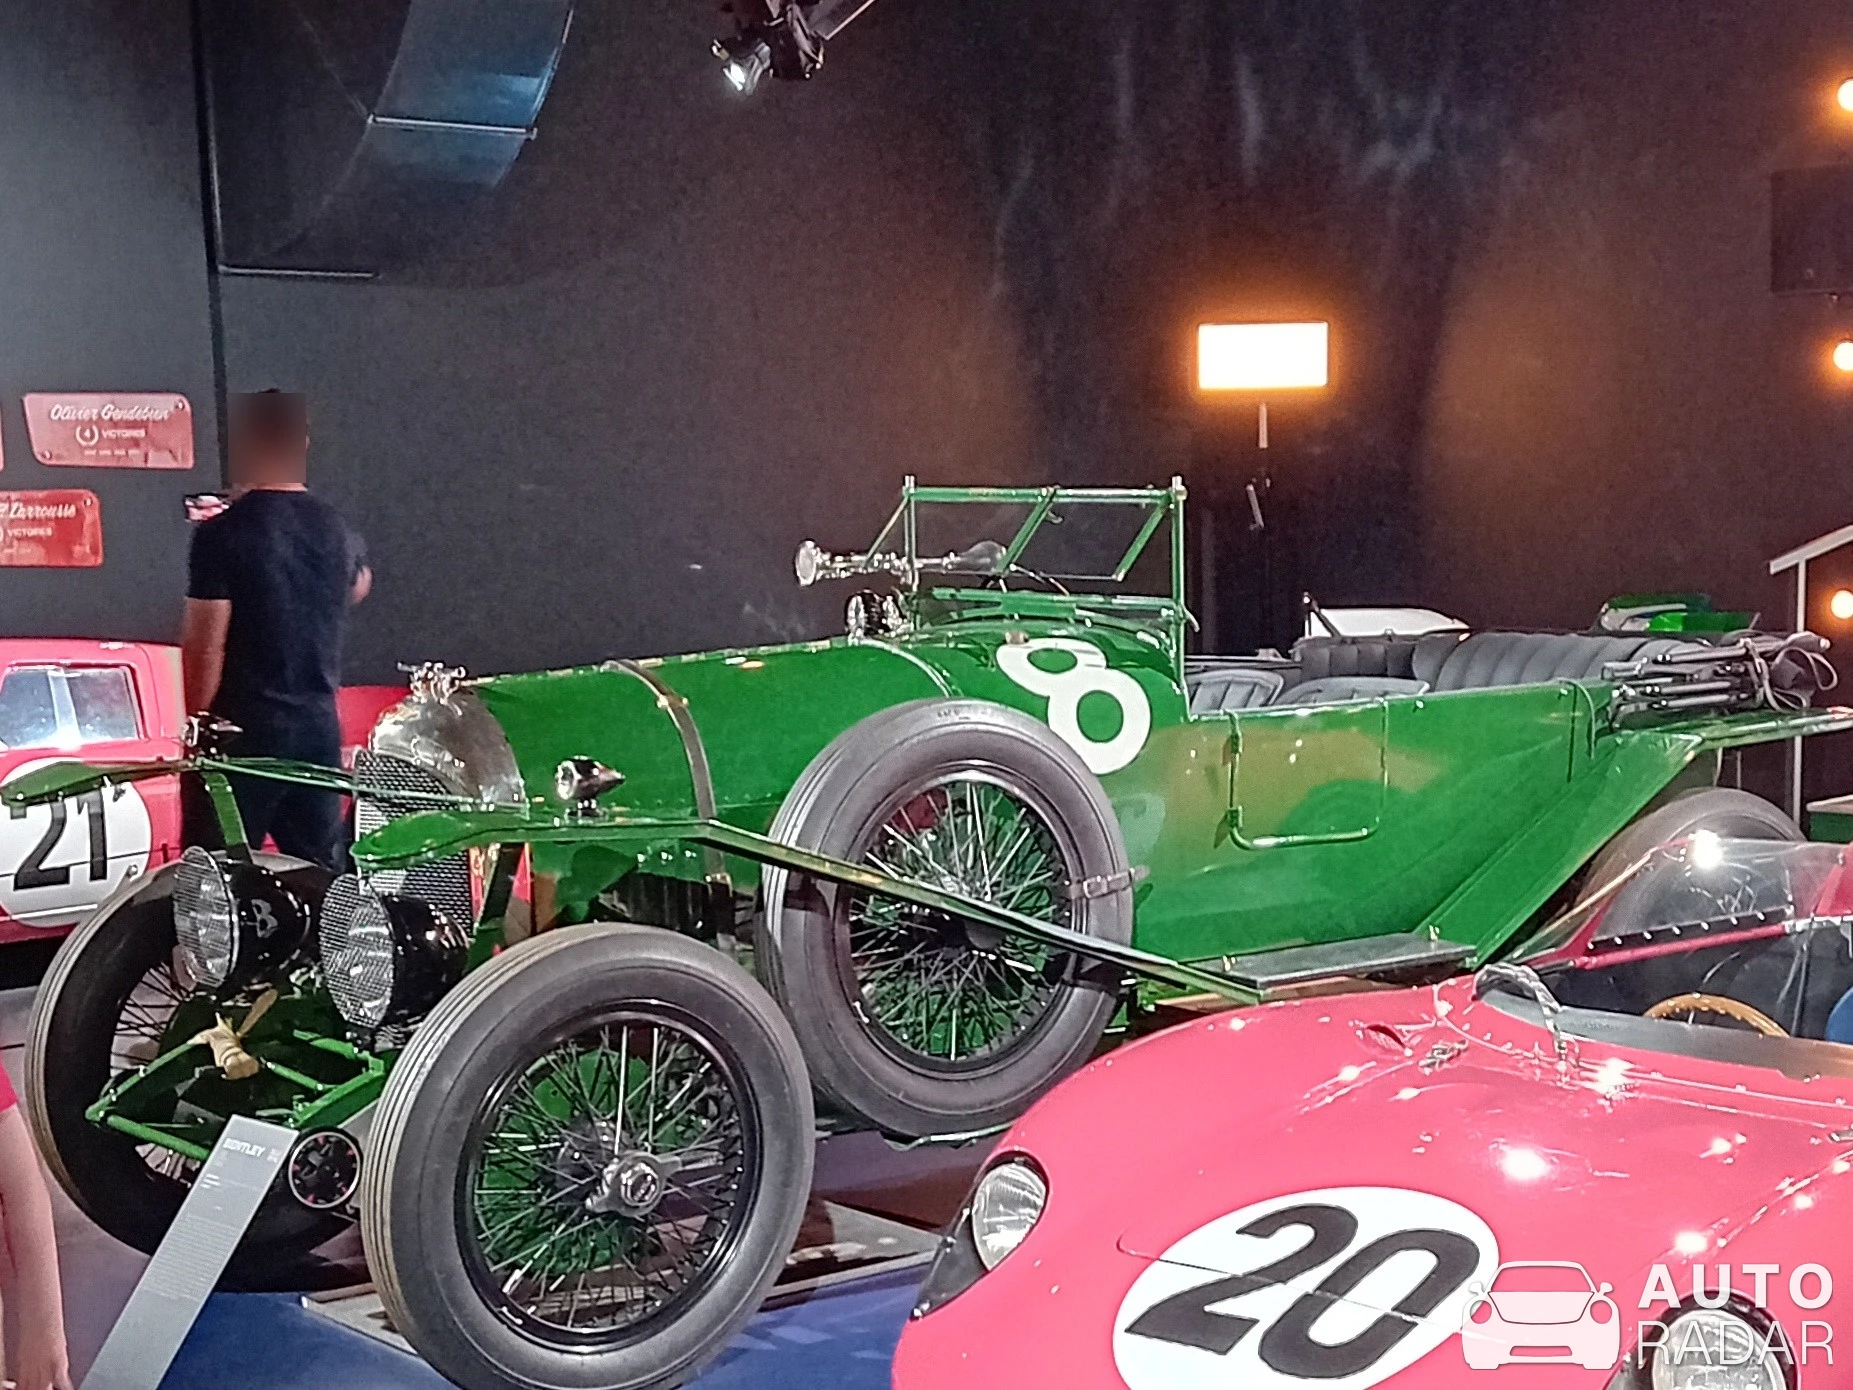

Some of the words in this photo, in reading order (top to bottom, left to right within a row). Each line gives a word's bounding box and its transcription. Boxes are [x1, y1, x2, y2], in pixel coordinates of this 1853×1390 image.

[50, 404, 99, 421] Olivier
[996, 637, 1151, 776] 8
[10, 789, 107, 891] 21
[1125, 1203, 1480, 1379] 20
